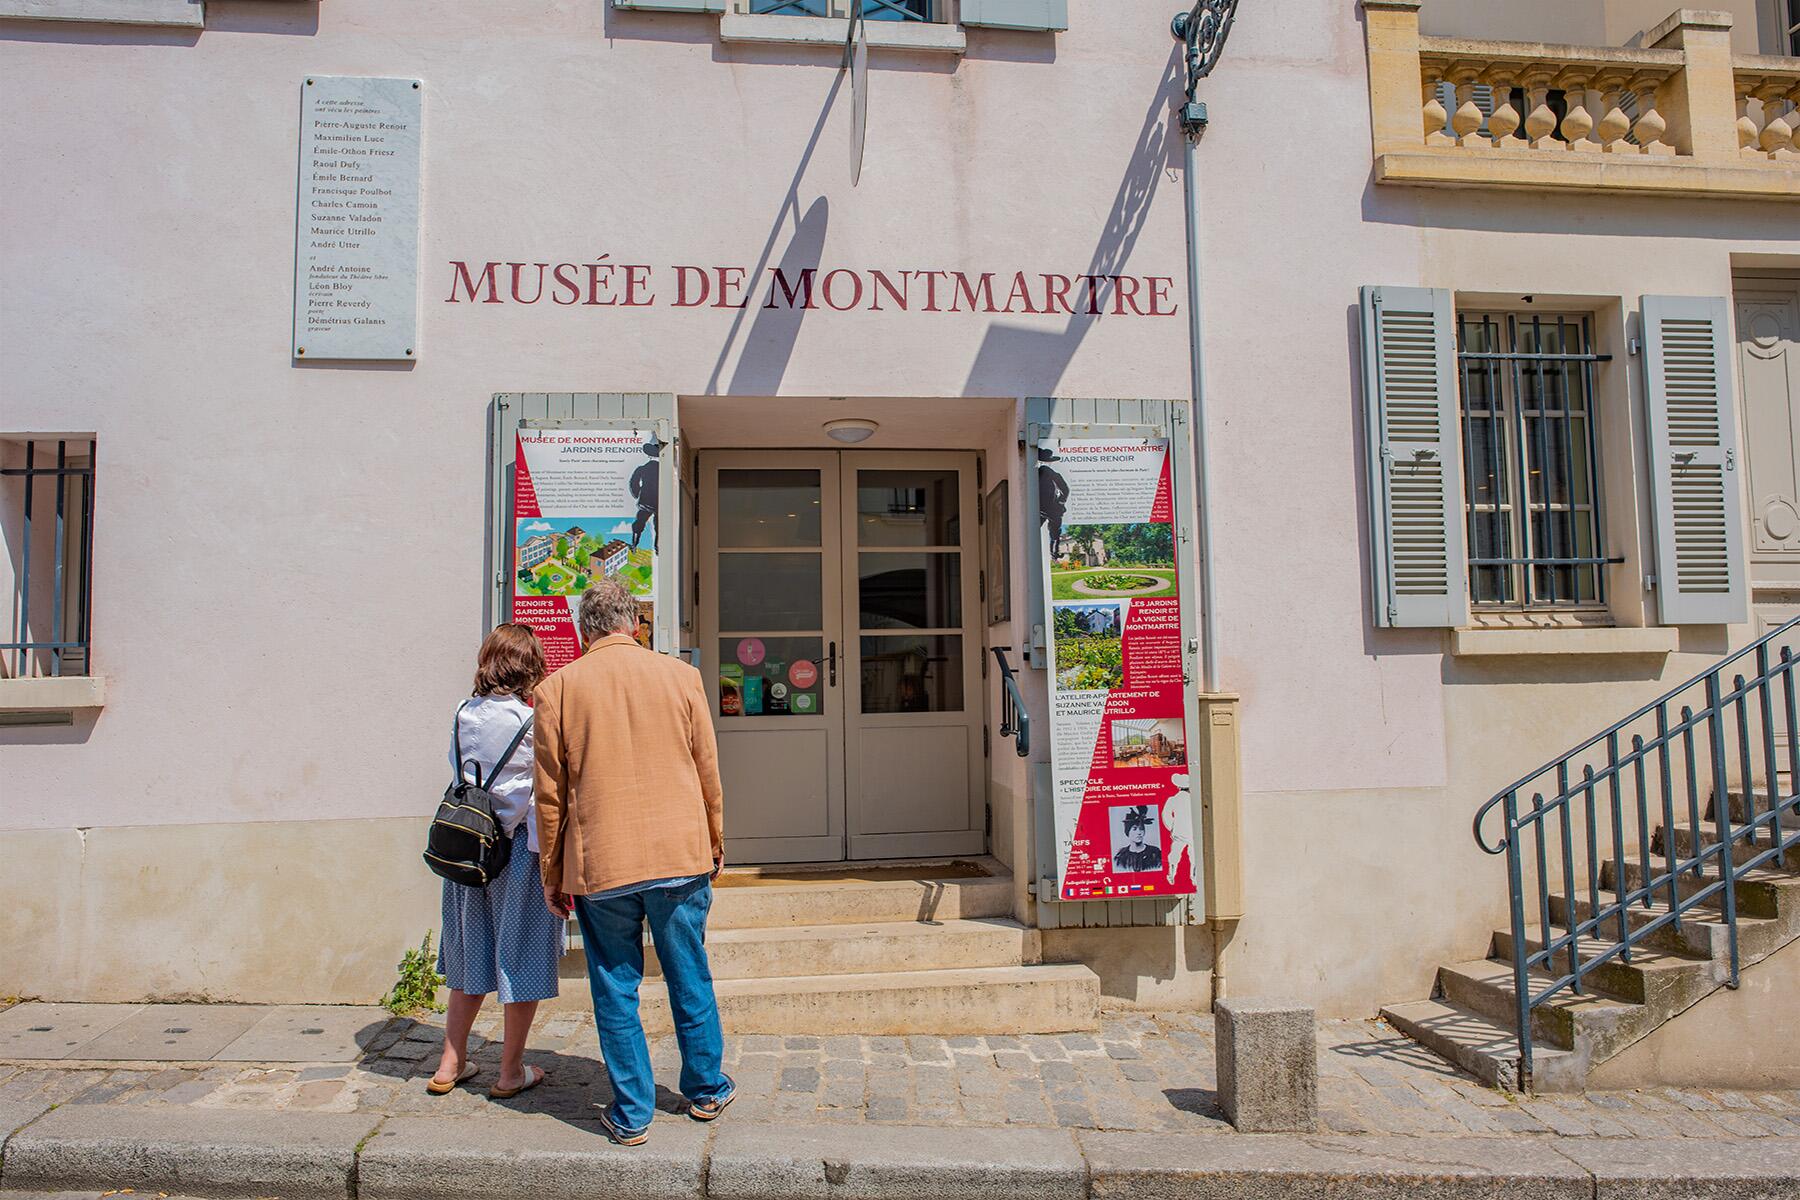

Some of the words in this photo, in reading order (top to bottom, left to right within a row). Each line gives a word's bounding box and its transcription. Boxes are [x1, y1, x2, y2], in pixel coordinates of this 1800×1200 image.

[379, 121, 408, 130] Renoir
[314, 134, 362, 142] Maximilien
[364, 135, 384, 143] Luce
[313, 145, 366, 156] Émile-Othon
[369, 148, 395, 156] Friesz
[313, 160, 338, 168] Raoul
[340, 161, 360, 170] Dufy
[312, 172, 337, 182] Émile
[340, 174, 374, 182] Bernard
[312, 187, 357, 196] Francisque
[360, 188, 392, 196] Poulbot
[312, 200, 344, 208] Charles
[346, 201, 378, 209] Camoin
[311, 214, 346, 222] Suzanne
[348, 214, 382, 222] Valadon
[310, 227, 345, 236] Maurice
[348, 228, 376, 236] Utrillo
[310, 241, 336, 249] André
[338, 265, 371, 273] Antoine
[309, 282, 330, 290] Léon
[332, 282, 353, 292] Bloy
[445, 253, 655, 306] MUSÉE
[670, 266, 749, 308] DE
[763, 267, 1178, 316] MONTMARTRE
[308, 300, 334, 308] Pierre
[336, 300, 372, 309] Reverdy
[308, 316, 352, 325] Démétrius
[353, 317, 386, 325] Galanis
[1103, 444, 1164, 452] MONTMARTRE
[1126, 622, 1180, 630] MONTMARTRE
[1103, 708, 1136, 716] UTRILLO
[1060, 778, 1104, 786] SPECTACLE
[1112, 784, 1160, 792] MONTMARTRE
